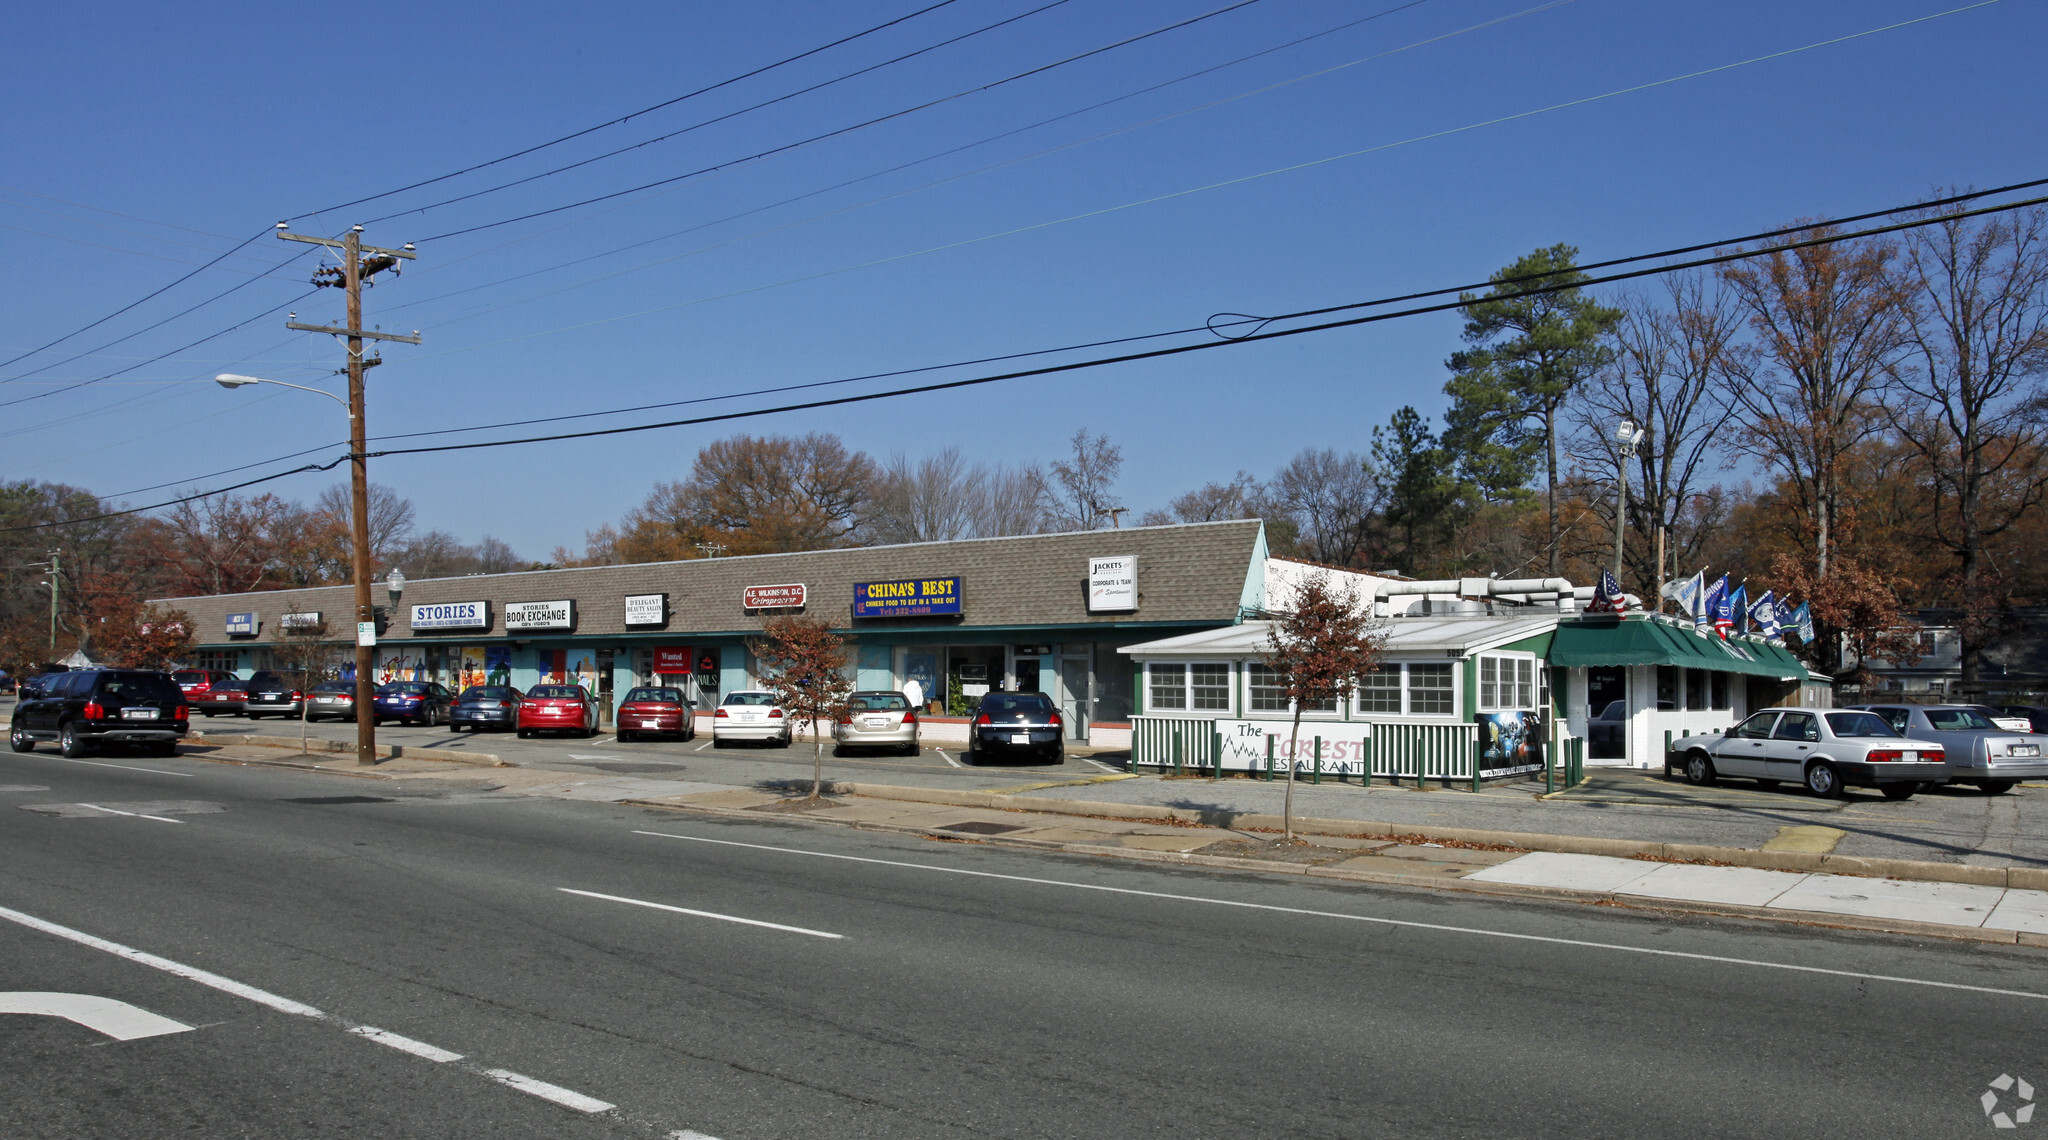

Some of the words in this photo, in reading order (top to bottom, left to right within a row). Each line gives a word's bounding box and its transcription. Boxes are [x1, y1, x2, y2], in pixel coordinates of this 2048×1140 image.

[1092, 561, 1122, 575] JACKETS
[867, 582, 915, 598] CHINA'S
[921, 580, 954, 596] BEST
[417, 604, 476, 620] STORIES
[506, 611, 526, 622] BOOK
[527, 609, 566, 621] EXCHANGE
[661, 652, 683, 660] Wanted
[697, 674, 718, 686] NAILS
[1237, 723, 1262, 737] The
